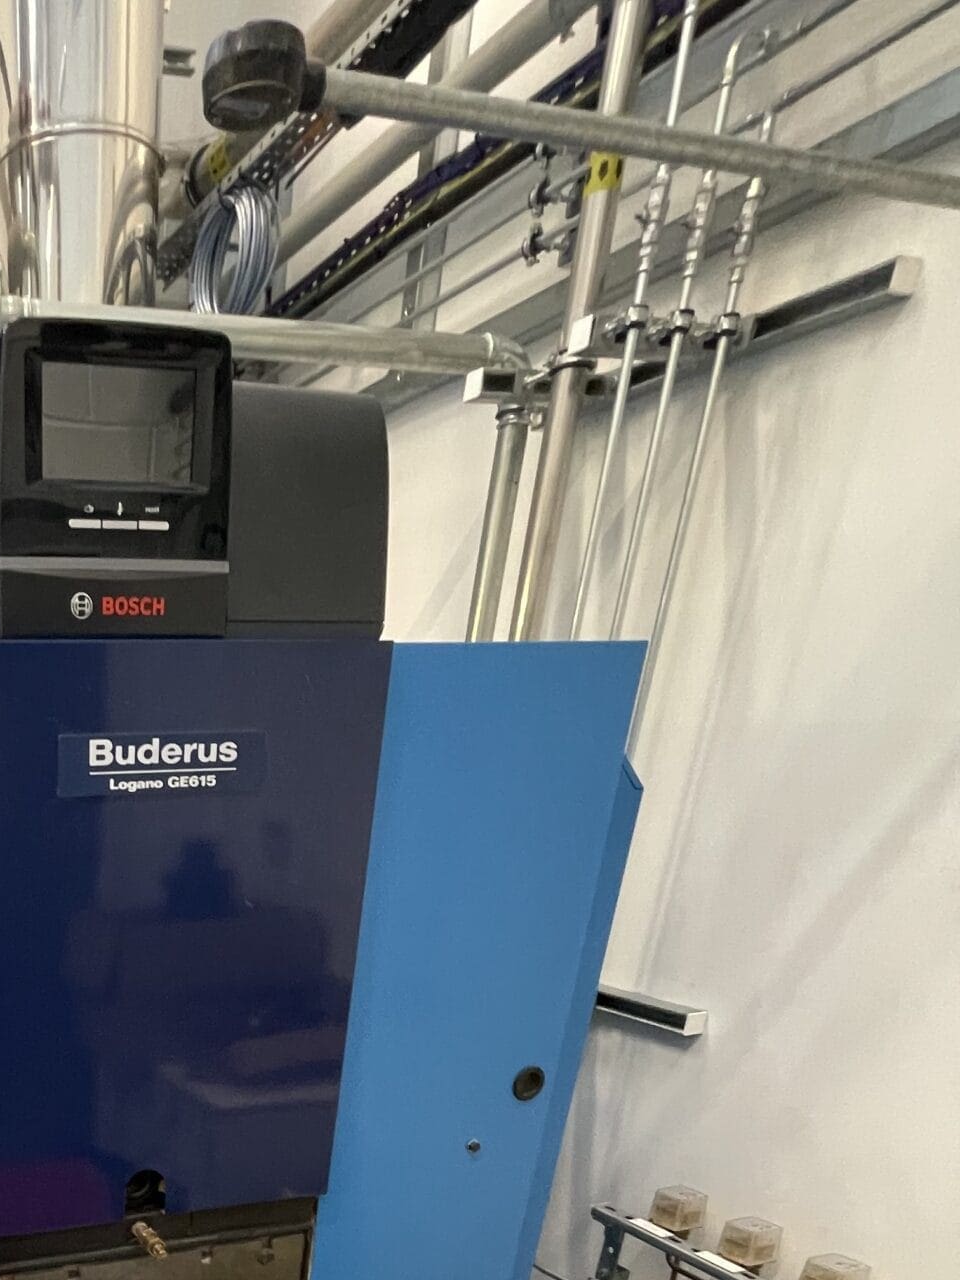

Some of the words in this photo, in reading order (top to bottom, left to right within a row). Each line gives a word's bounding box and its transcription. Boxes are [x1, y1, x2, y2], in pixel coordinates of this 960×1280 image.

[102, 596, 165, 616] BOSCH
[89, 738, 238, 766] Buderus
[109, 778, 164, 792] Logano
[167, 775, 217, 788] GE615
